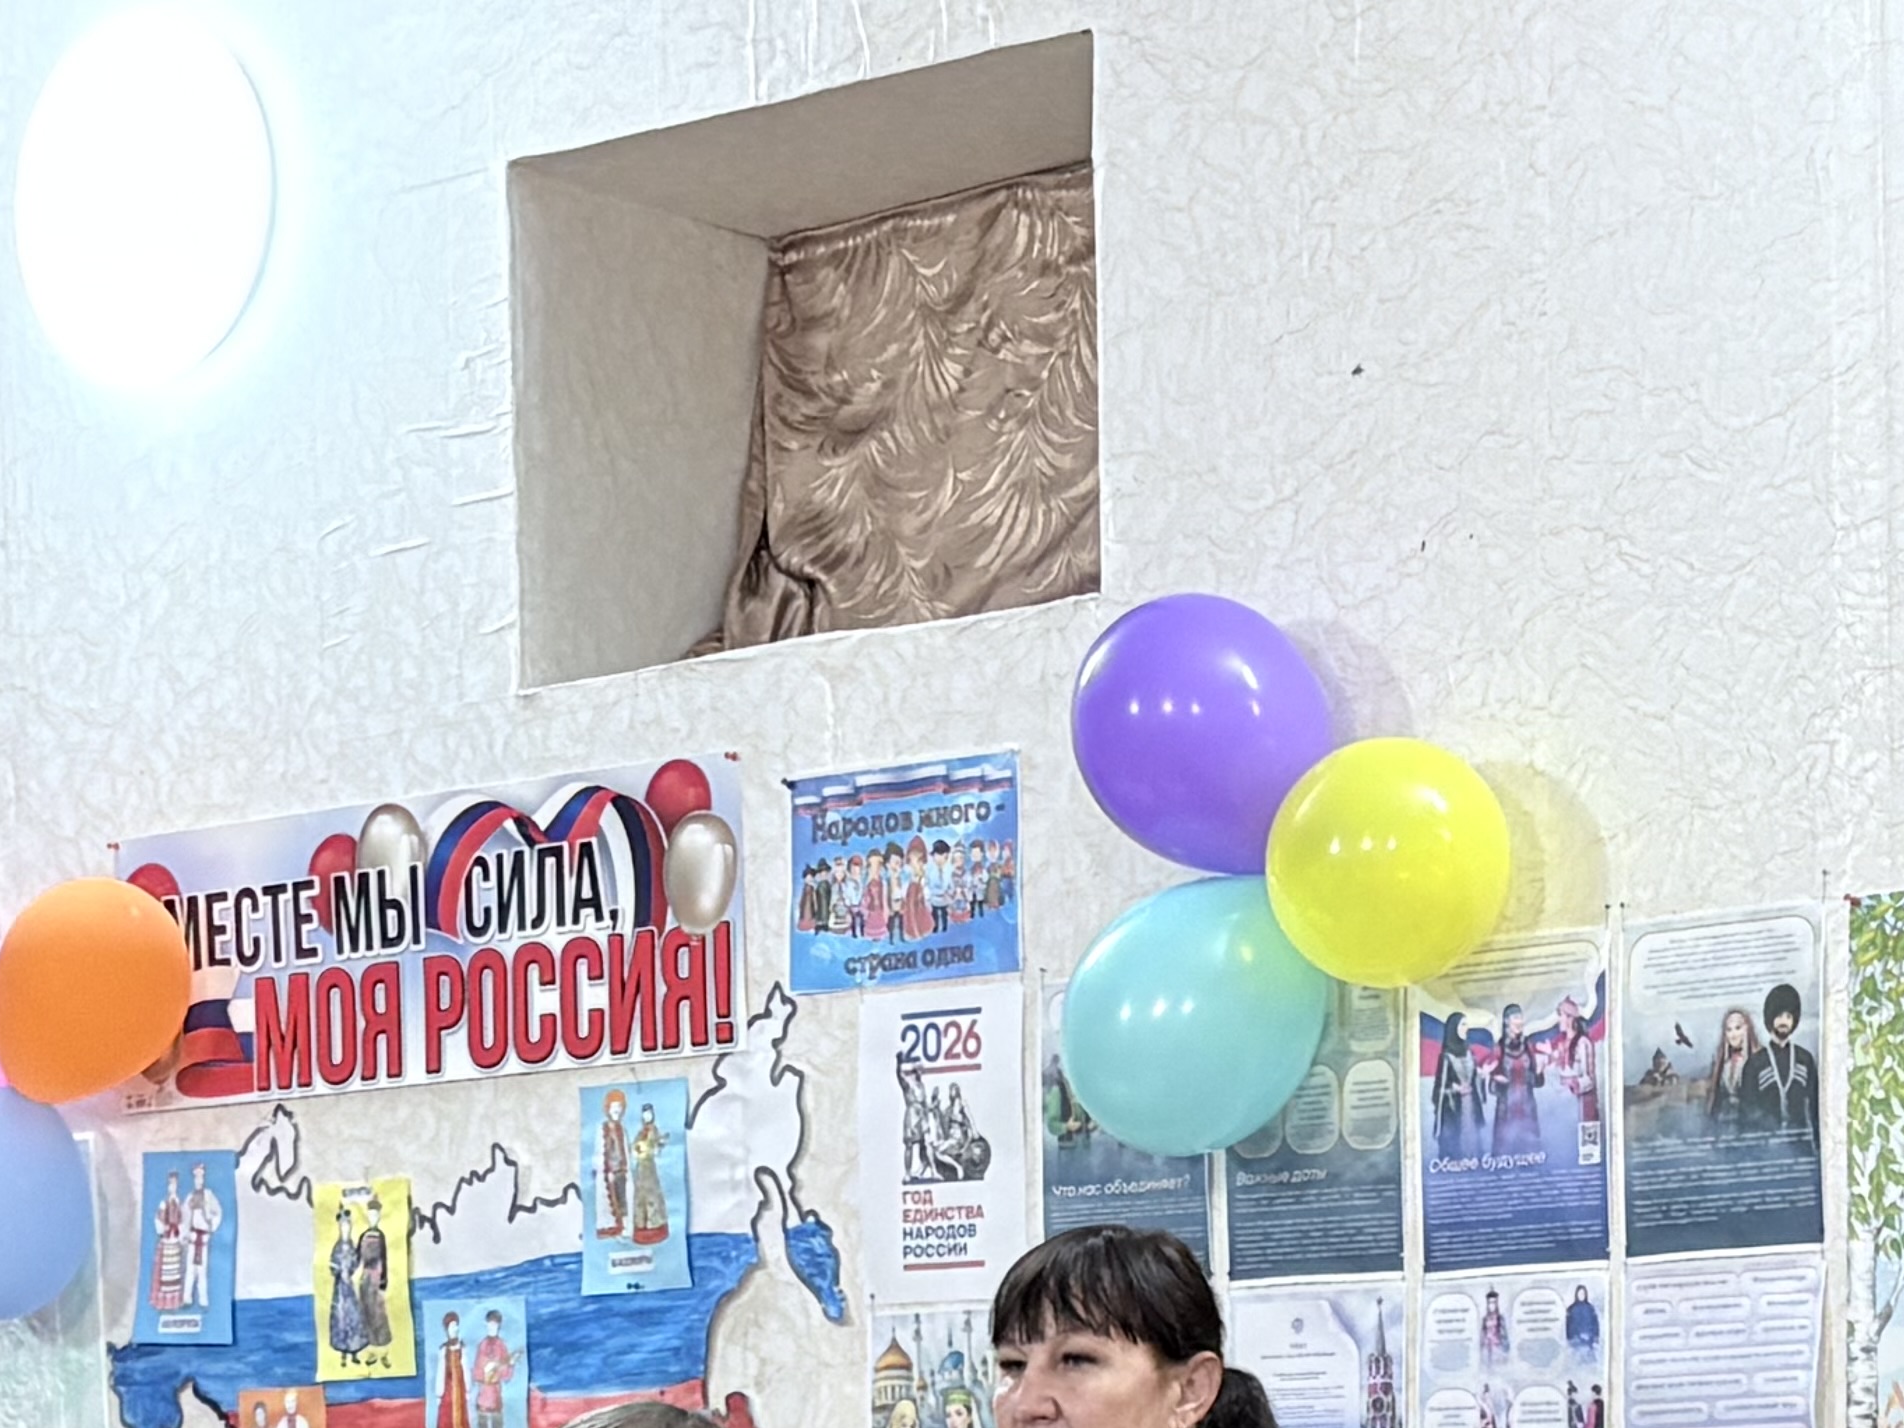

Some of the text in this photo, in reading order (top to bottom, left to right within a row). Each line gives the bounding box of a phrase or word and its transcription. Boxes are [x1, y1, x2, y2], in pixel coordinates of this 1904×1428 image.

[812, 808, 913, 846] Народов
[917, 801, 991, 833] много
[163, 840, 621, 971] МЕСТЕ МЫ СИЛА,
[844, 944, 974, 979] страна одна
[254, 920, 735, 1092] МОЯ РОССИЯ!
[900, 1019, 982, 1063] 2026
[902, 1190, 933, 1206] ГОД
[902, 1205, 984, 1225] ЕДИНСТВА
[902, 1224, 977, 1242] НАРОДОВ
[902, 1242, 968, 1259] РОССИИ
